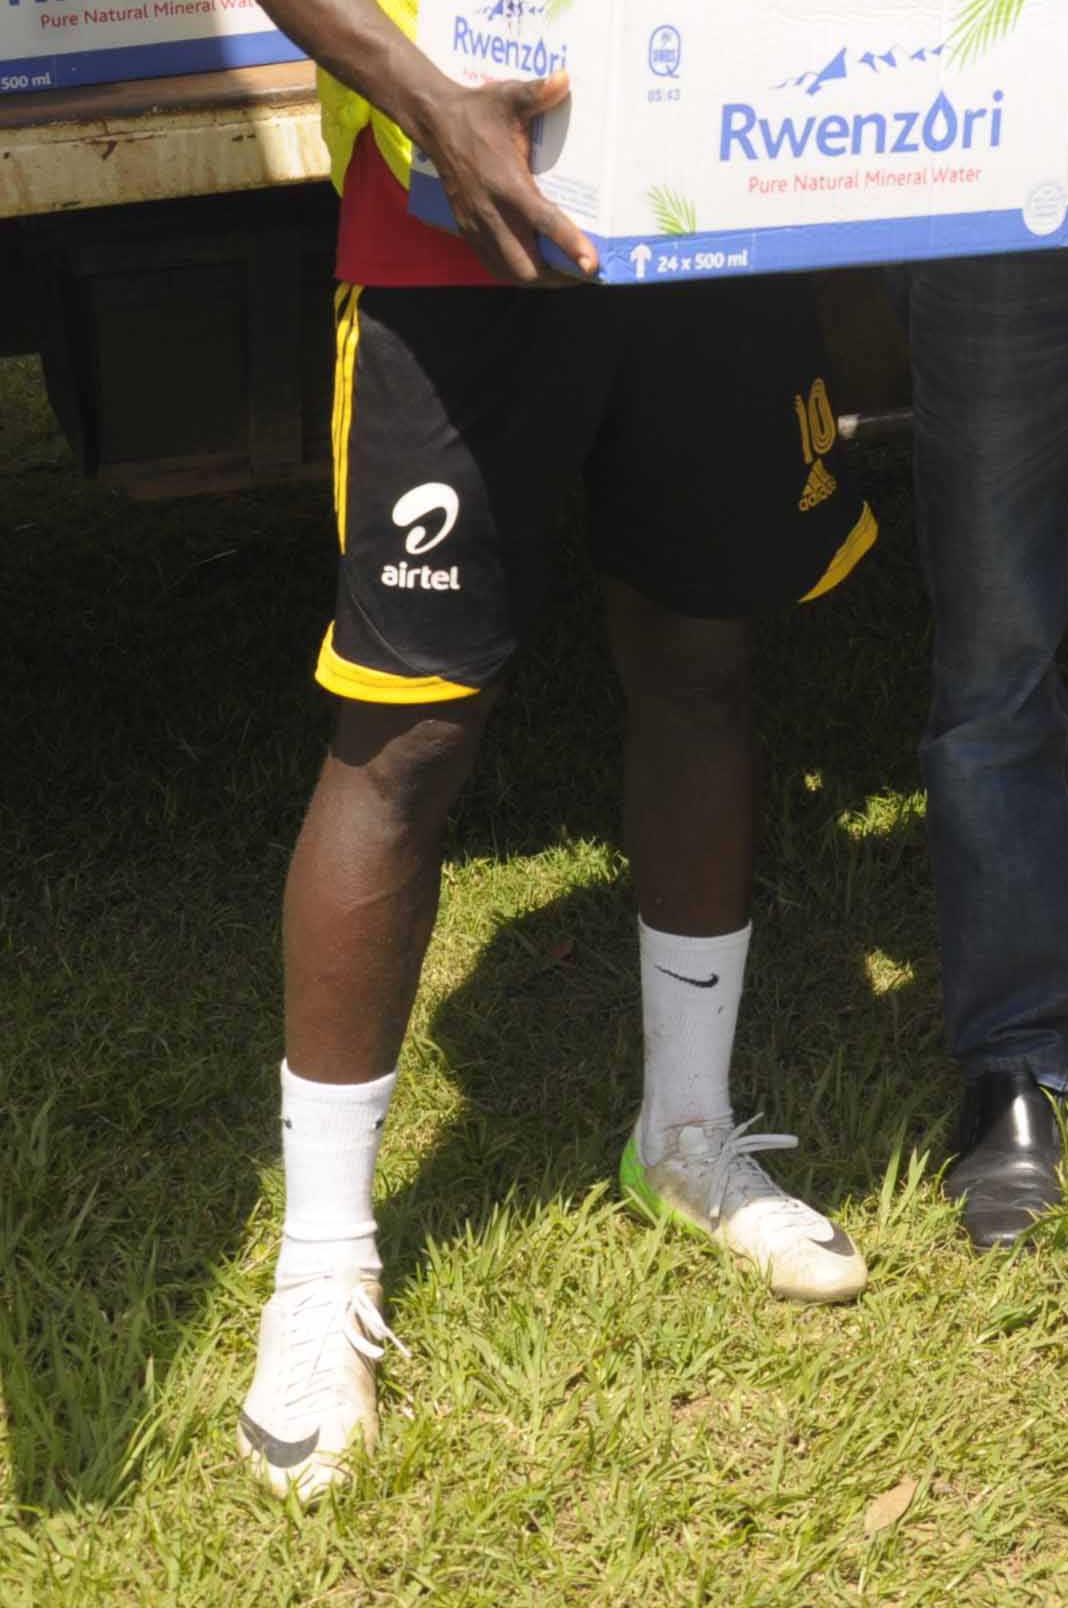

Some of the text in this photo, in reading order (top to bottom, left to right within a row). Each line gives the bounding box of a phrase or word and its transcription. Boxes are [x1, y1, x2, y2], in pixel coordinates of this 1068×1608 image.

[40, 10, 79, 29] Pure
[84, 3, 149, 25] Natural
[453, 15, 567, 76] Rwenzori
[1, 73, 51, 89] 500 ml
[719, 90, 1004, 162] Rwenzori
[748, 166, 983, 194] Pure Natural Mineral Water
[657, 256, 678, 272] 24
[695, 253, 725, 269] 500
[729, 252, 748, 268] ml
[381, 560, 461, 591] airtel
